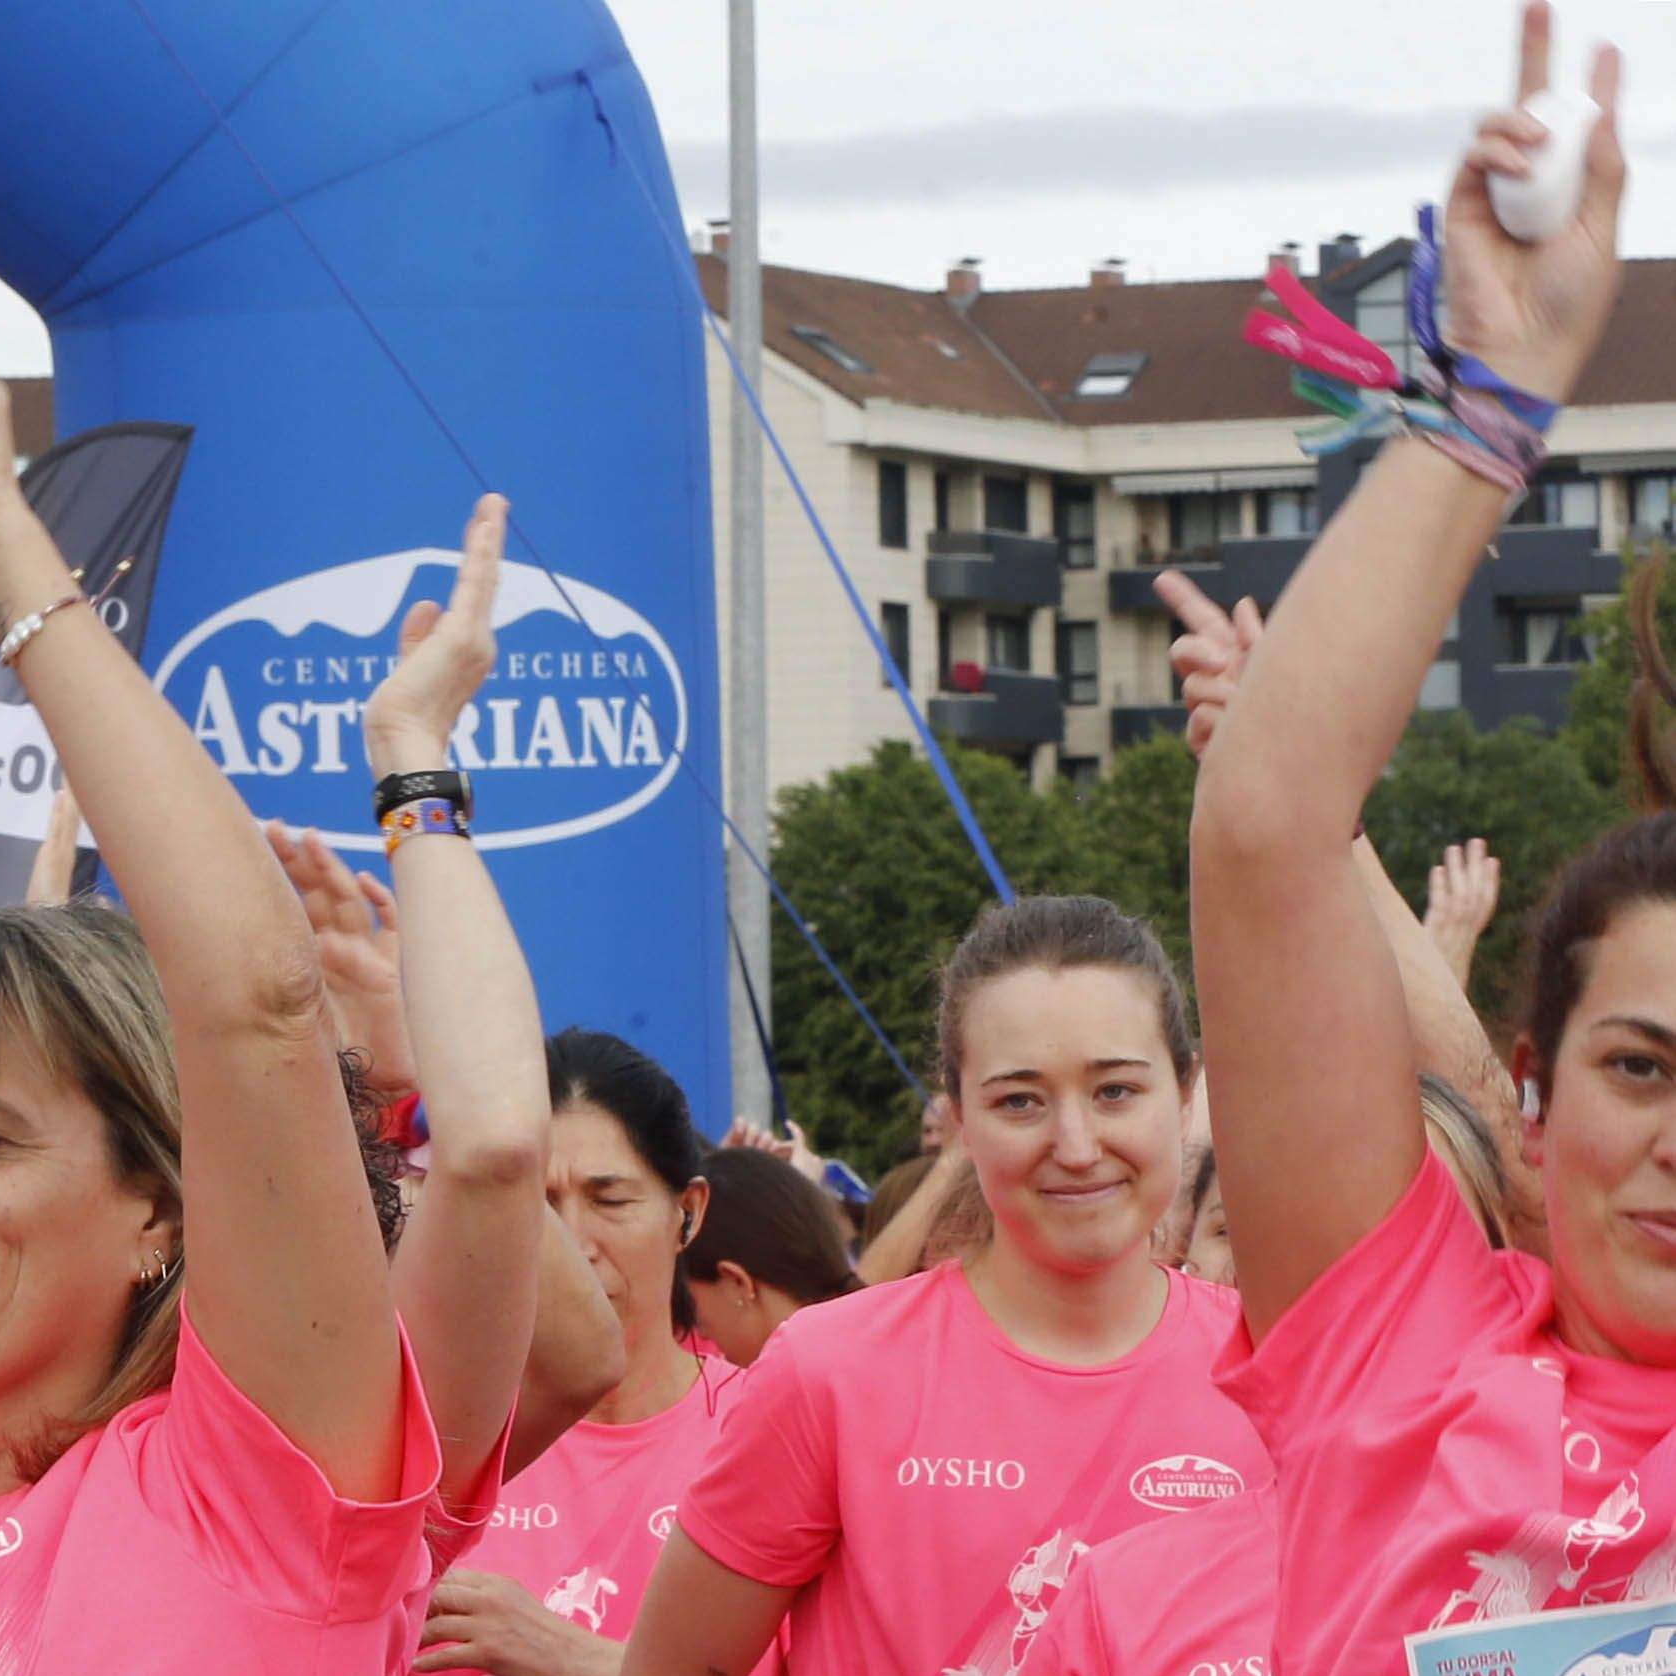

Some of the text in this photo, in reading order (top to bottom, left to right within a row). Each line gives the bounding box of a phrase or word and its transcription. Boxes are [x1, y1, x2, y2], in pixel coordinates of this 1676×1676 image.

[194, 665, 663, 776] ASTRIANA
[897, 1456, 1026, 1490] OYSHO
[1140, 1474, 1235, 1498] ASTURIANA
[1437, 1658, 1453, 1674] TU
[1458, 1649, 1517, 1669] DORSAL
